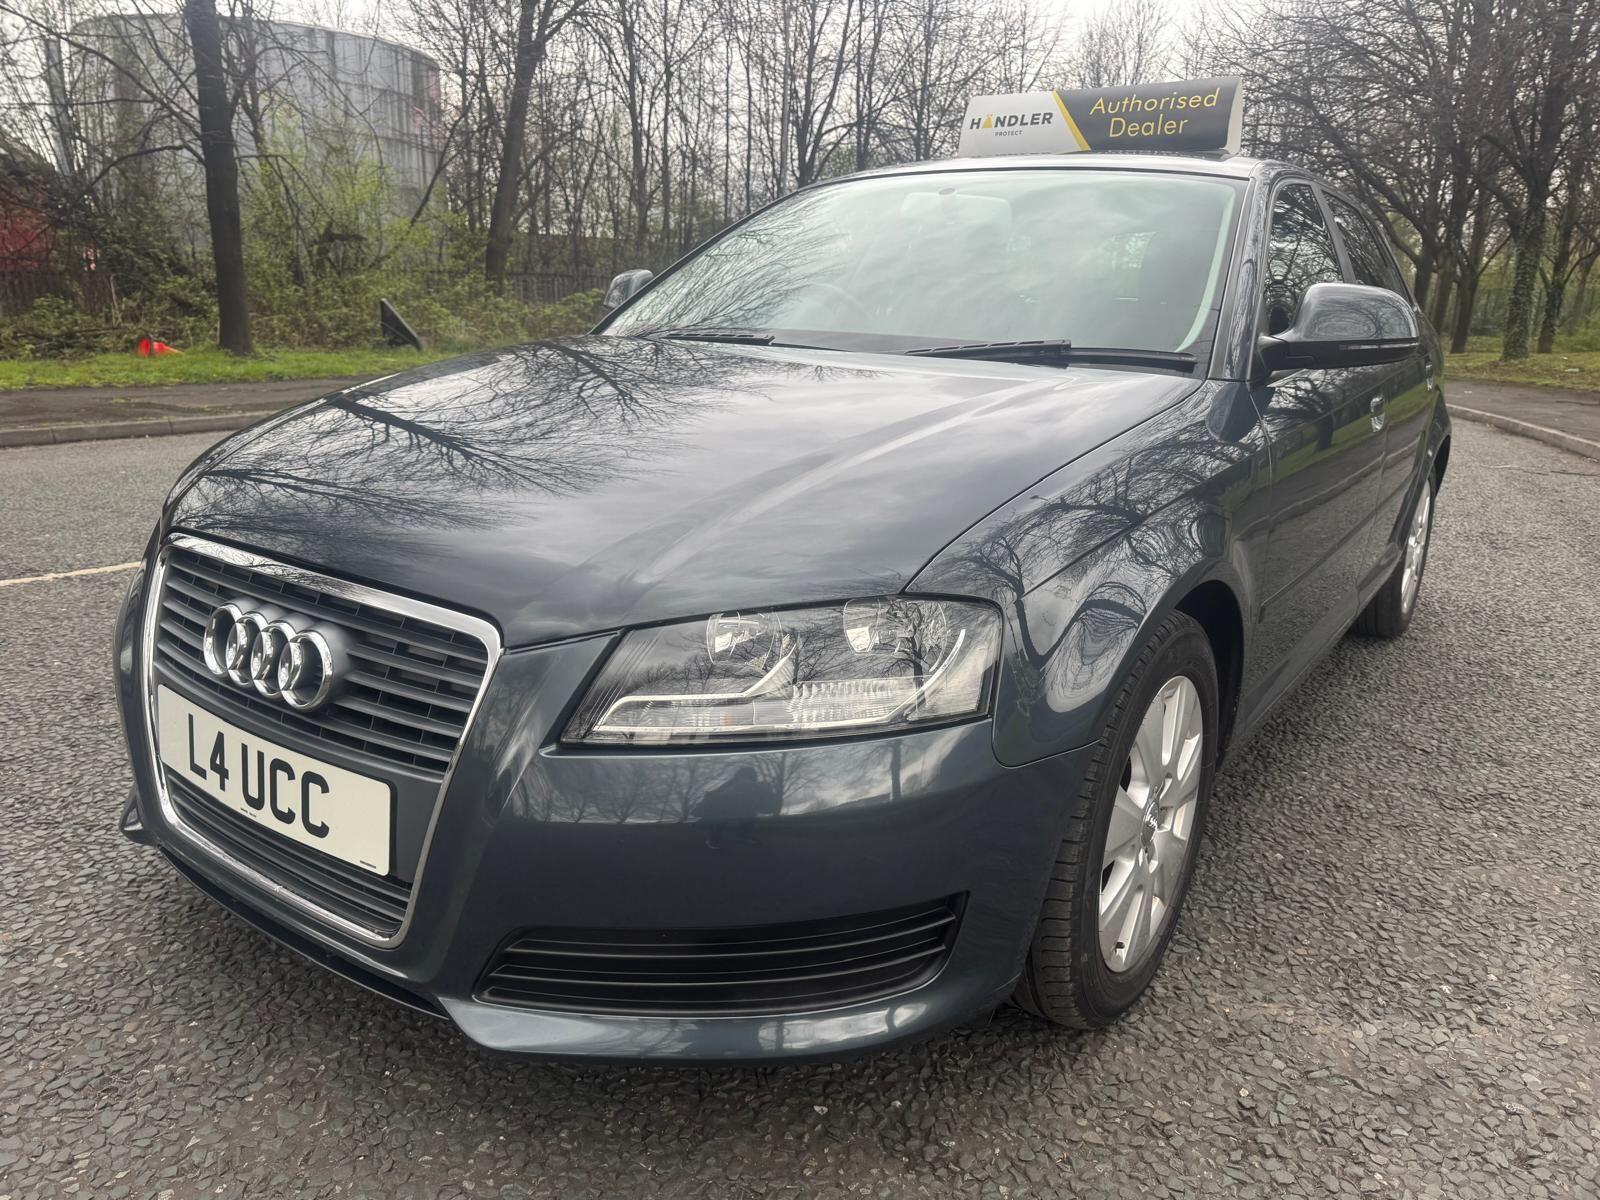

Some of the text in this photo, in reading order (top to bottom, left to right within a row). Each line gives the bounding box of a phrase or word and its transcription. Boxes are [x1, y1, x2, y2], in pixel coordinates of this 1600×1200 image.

[1089, 88, 1220, 115] Authorised
[1108, 114, 1189, 138] Dealer
[188, 712, 330, 839] L4 UCC
